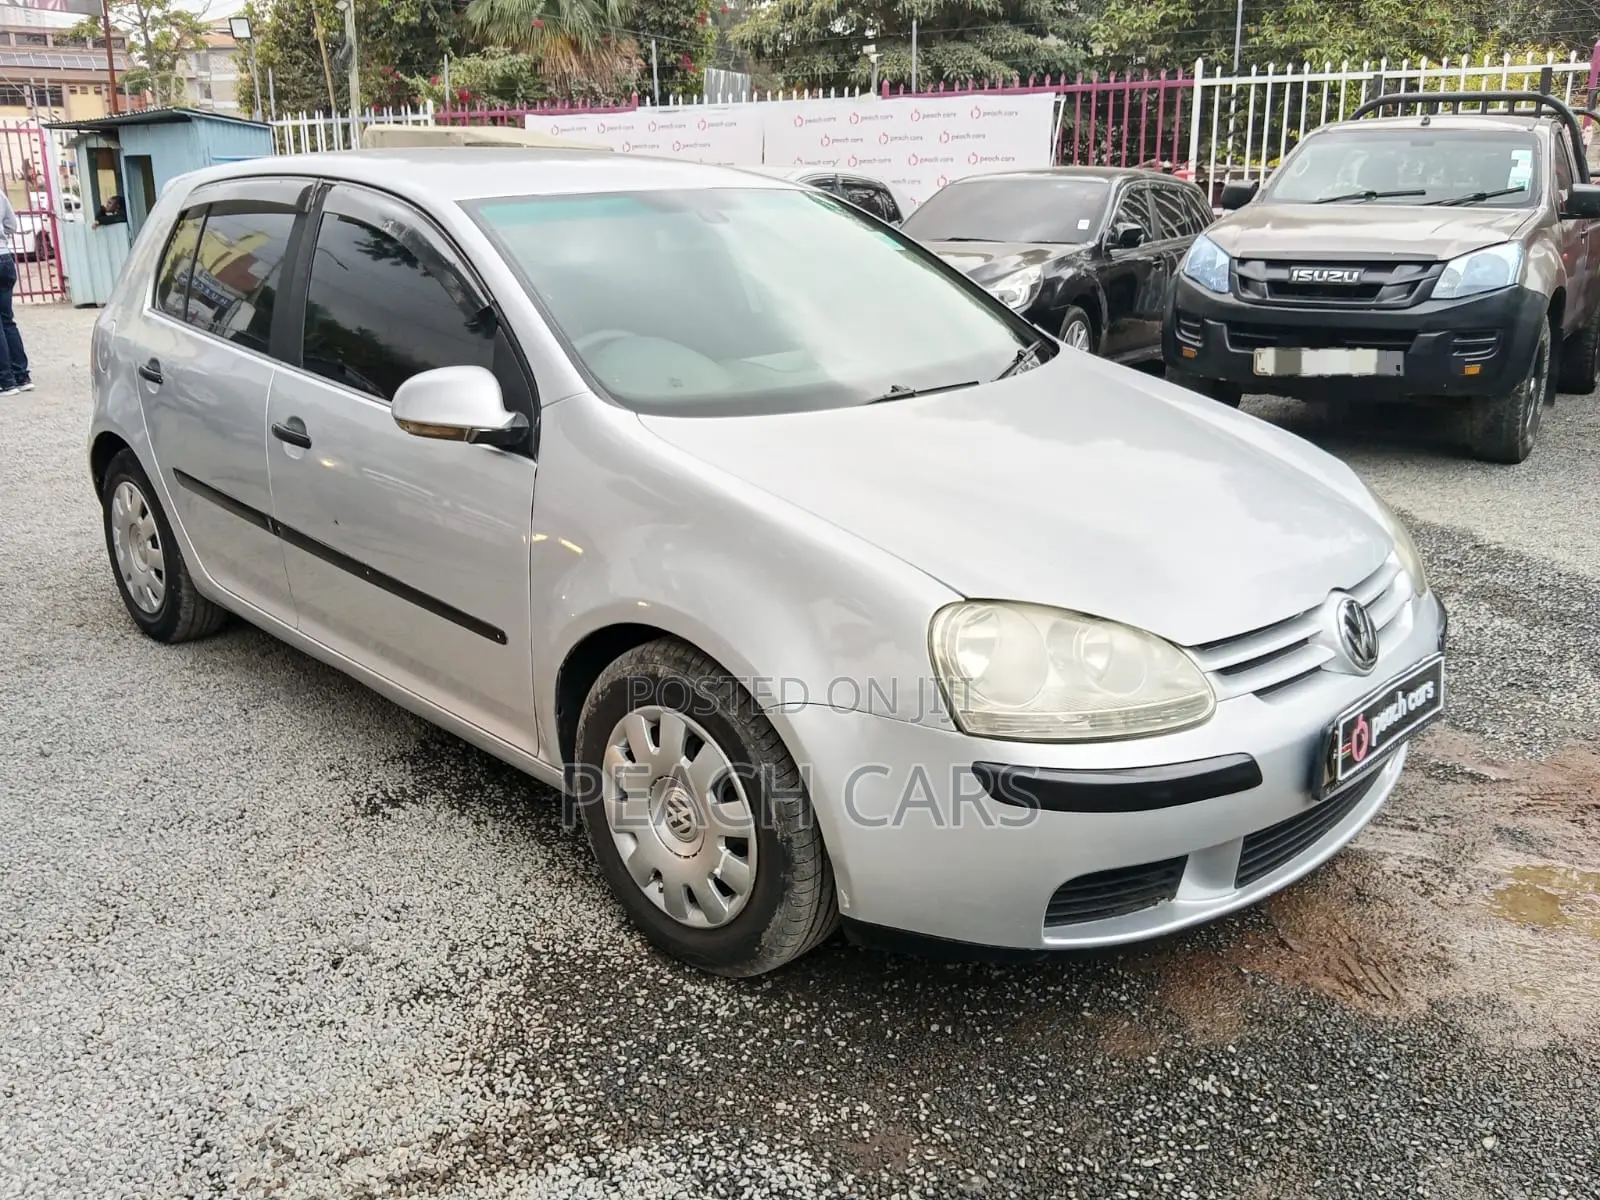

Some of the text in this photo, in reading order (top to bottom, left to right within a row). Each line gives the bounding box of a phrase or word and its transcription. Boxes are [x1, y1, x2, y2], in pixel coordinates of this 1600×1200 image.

[1292, 269, 1359, 283] ISUZU
[1371, 680, 1434, 747] peach cars
